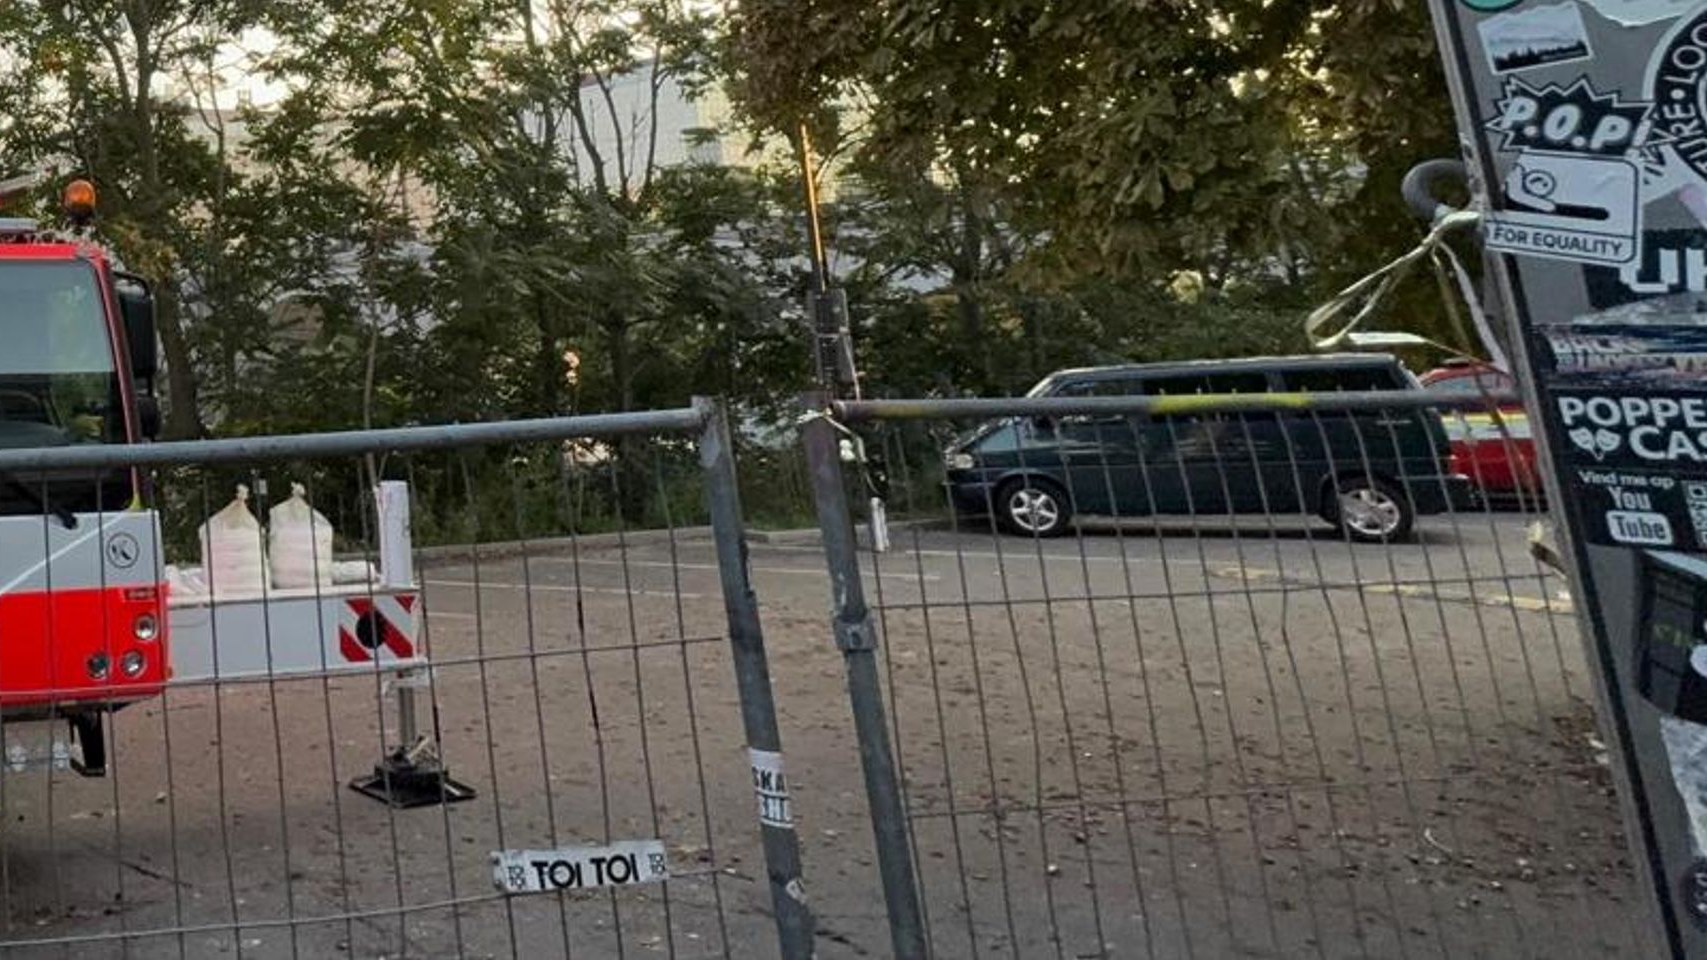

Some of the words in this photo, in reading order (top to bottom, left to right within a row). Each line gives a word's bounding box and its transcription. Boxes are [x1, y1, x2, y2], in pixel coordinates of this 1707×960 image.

[1494, 227, 1527, 245] FOR
[1532, 232, 1622, 256] EQUALITY
[1608, 486, 1651, 509] You
[1612, 514, 1666, 540] Tube
[530, 860, 582, 889] TOI
[590, 853, 639, 885] TOI
